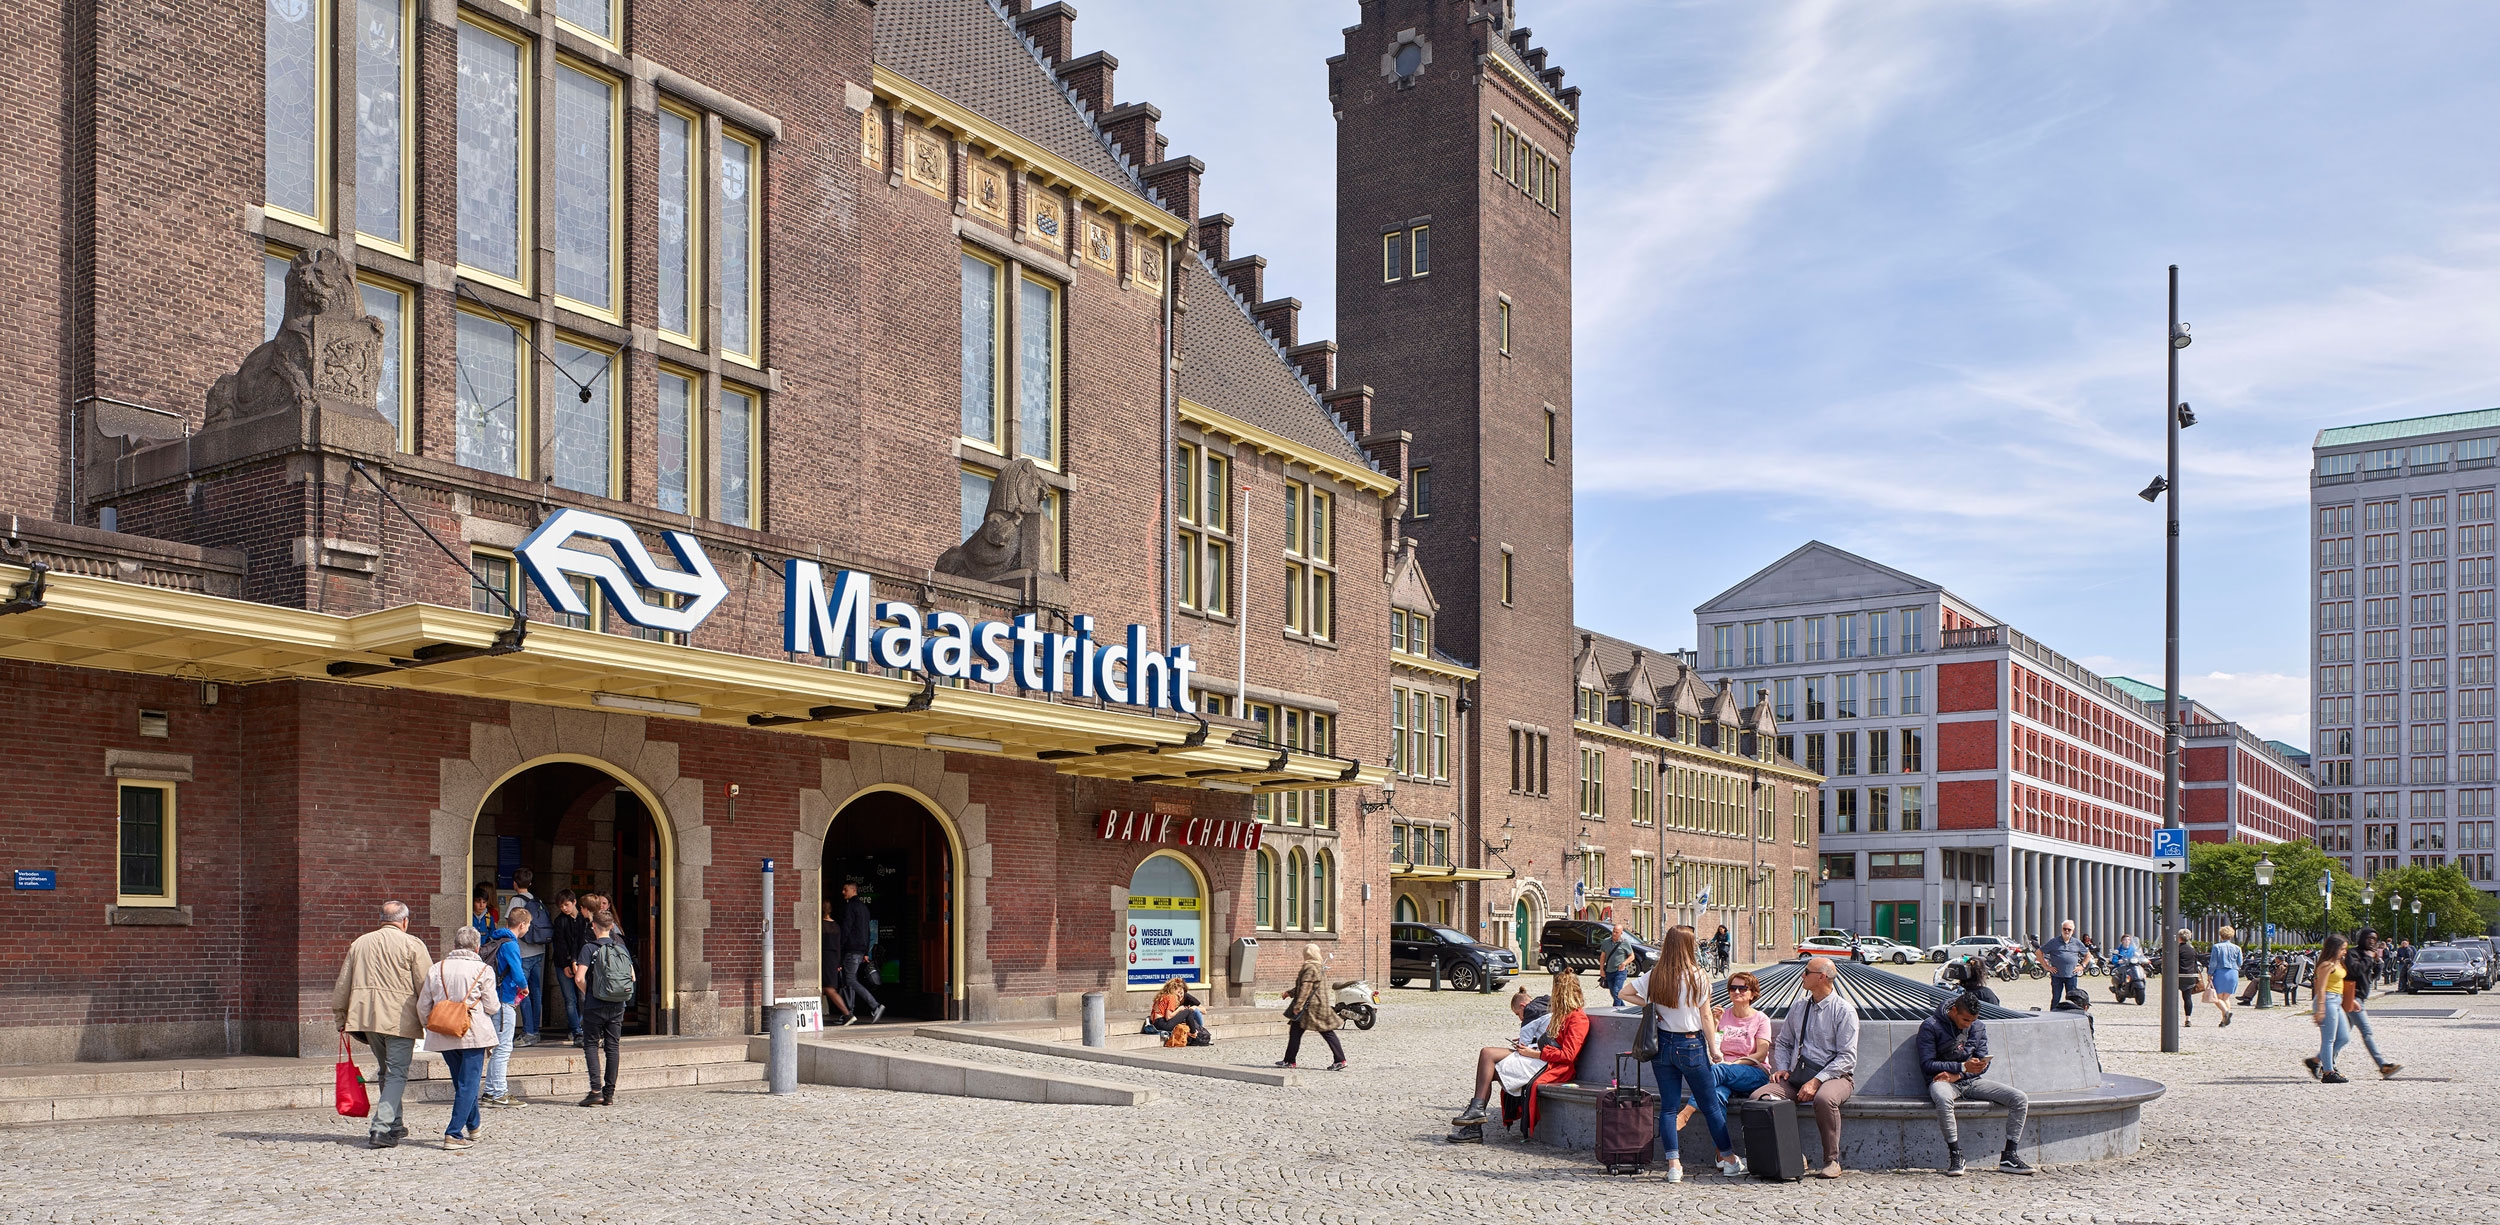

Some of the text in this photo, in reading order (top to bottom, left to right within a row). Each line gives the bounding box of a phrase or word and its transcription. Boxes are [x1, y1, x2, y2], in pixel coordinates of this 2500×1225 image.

[784, 559, 1196, 713] Maastricht
[1104, 809, 1268, 850] BANK CHANGE
[2158, 832, 2171, 850] P
[1141, 929, 1173, 937] WISSELEN
[1141, 938, 1195, 946] VREEMDE VALUTA
